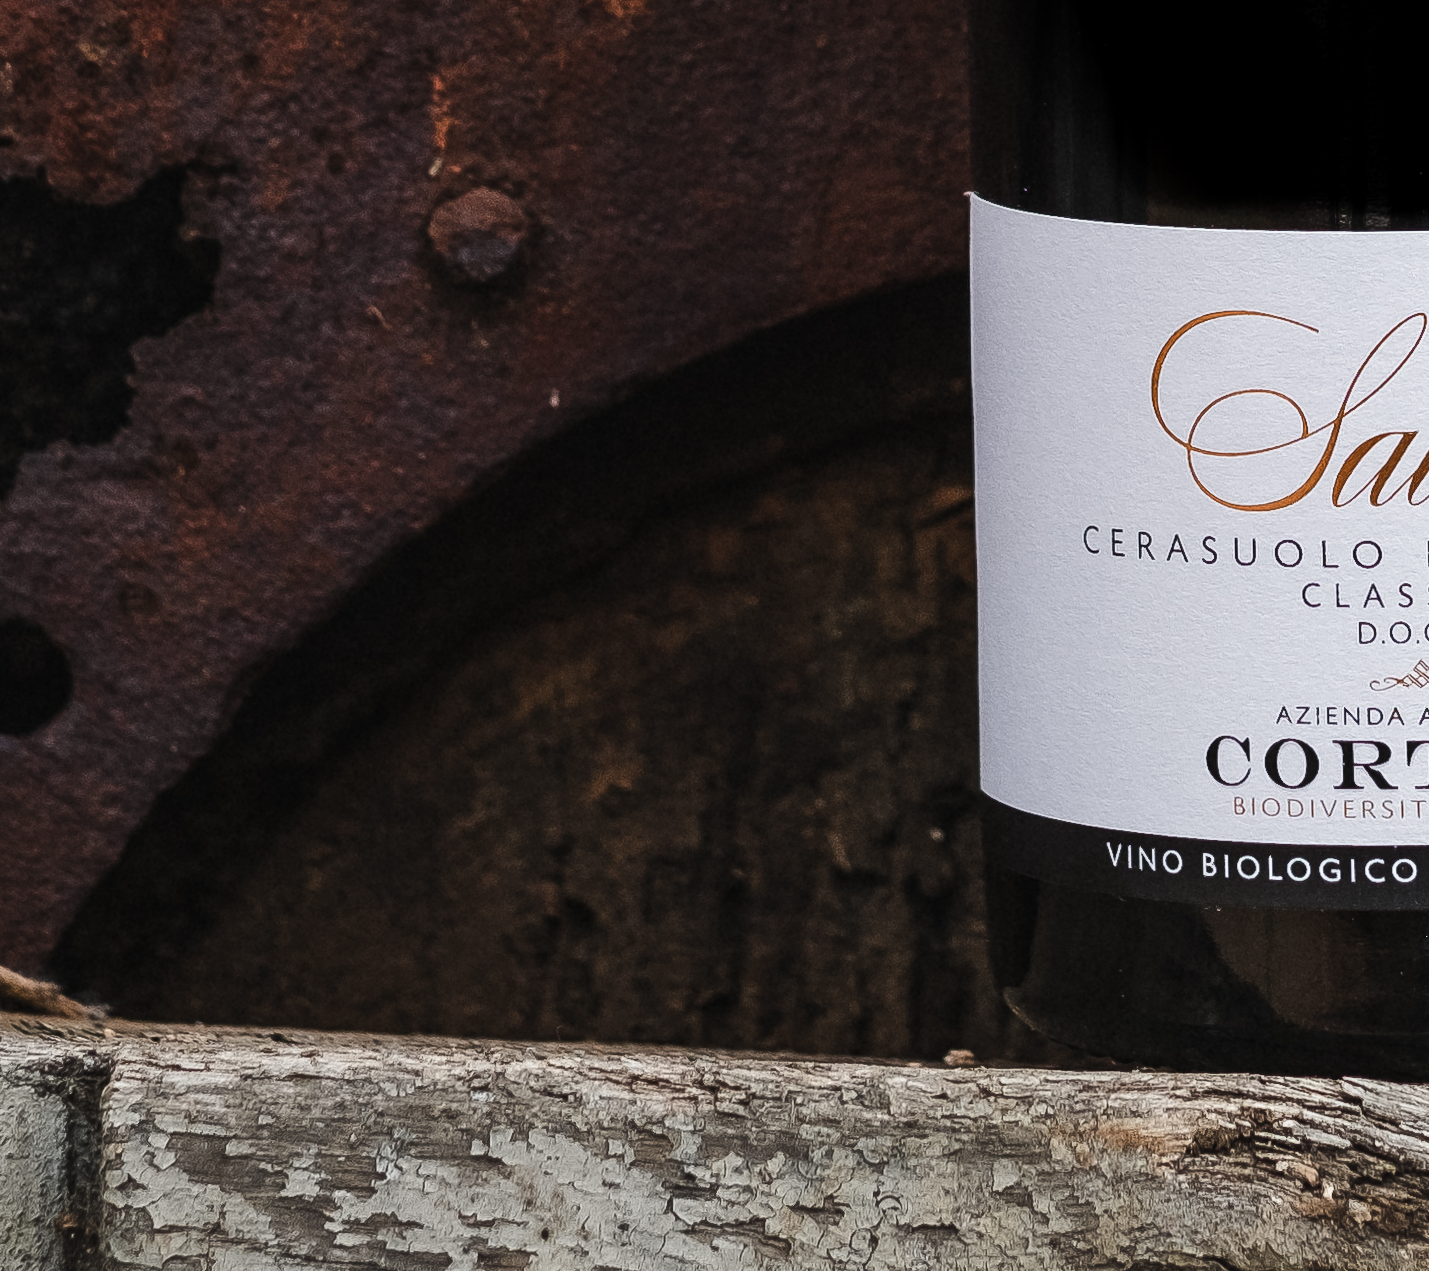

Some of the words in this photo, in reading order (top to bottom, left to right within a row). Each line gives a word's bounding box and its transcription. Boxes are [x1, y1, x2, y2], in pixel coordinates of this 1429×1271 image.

[1082, 525, 1383, 570] CERASUOLO
[1275, 704, 1405, 727] AZIENDA
[1105, 841, 1184, 875] VINO
[1202, 852, 1418, 884] BIOLOGICO
